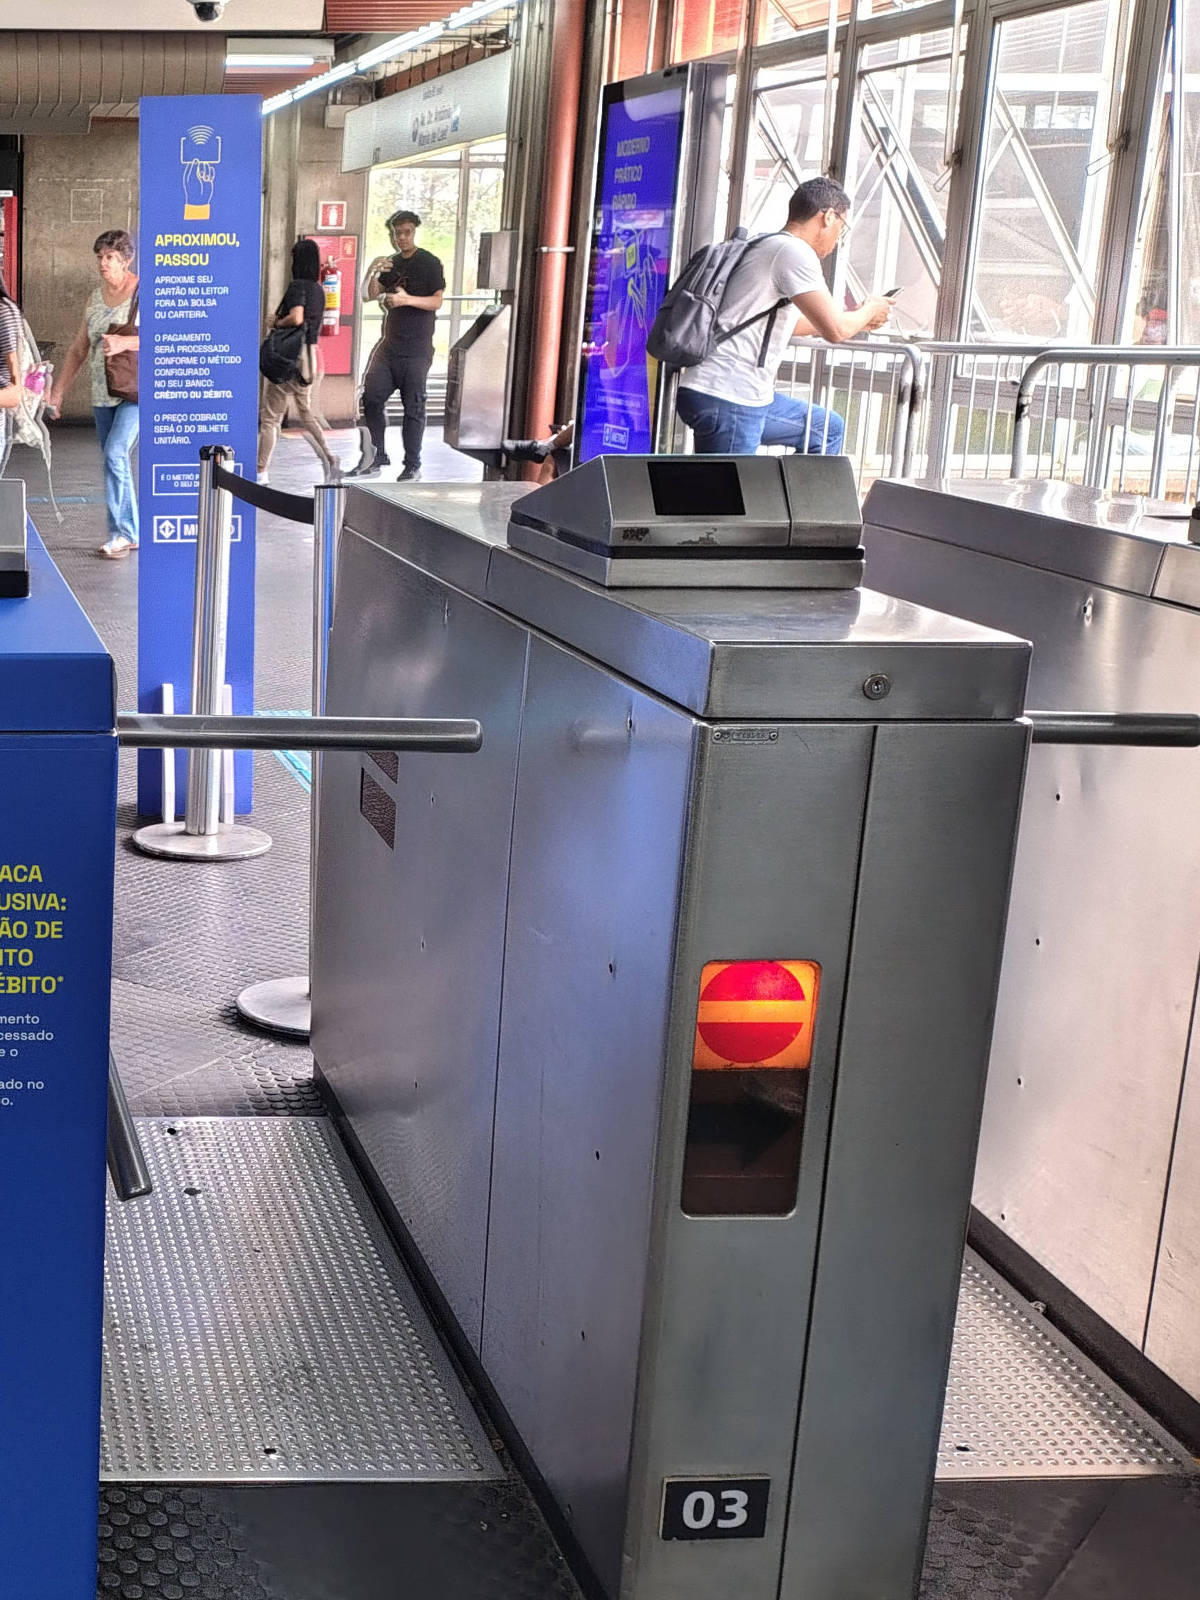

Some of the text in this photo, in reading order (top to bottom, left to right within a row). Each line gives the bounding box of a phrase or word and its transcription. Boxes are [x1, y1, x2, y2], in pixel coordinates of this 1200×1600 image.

[155, 233, 240, 248] APROXIMOU,
[155, 254, 210, 266] PASSOU
[155, 286, 228, 296] CARTÃO NO LEITOR
[191, 298, 216, 306] BOLSA
[168, 310, 208, 318] CARTEIRA.
[162, 334, 210, 342] PAGAMENTO
[154, 344, 175, 354] SERÁ
[154, 357, 198, 365] CONFORME
[208, 355, 241, 364] MÉTODO
[154, 368, 210, 376] CONFIGURADO
[168, 380, 183, 388] SEU
[185, 380, 214, 388] BANCO:
[154, 390, 188, 399] CRÉDITO
[203, 389, 234, 398] DÉBITO.
[154, 413, 228, 423] O PREÇO COBRADO
[154, 424, 174, 433] SERÁ
[198, 424, 229, 432] BILHETE
[154, 435, 191, 444] UNITÁRIO.
[35, 921, 63, 938] DE
[10, 1048, 18, 1056] o
[27, 1081, 44, 1089] no
[682, 1490, 748, 1529] 03
